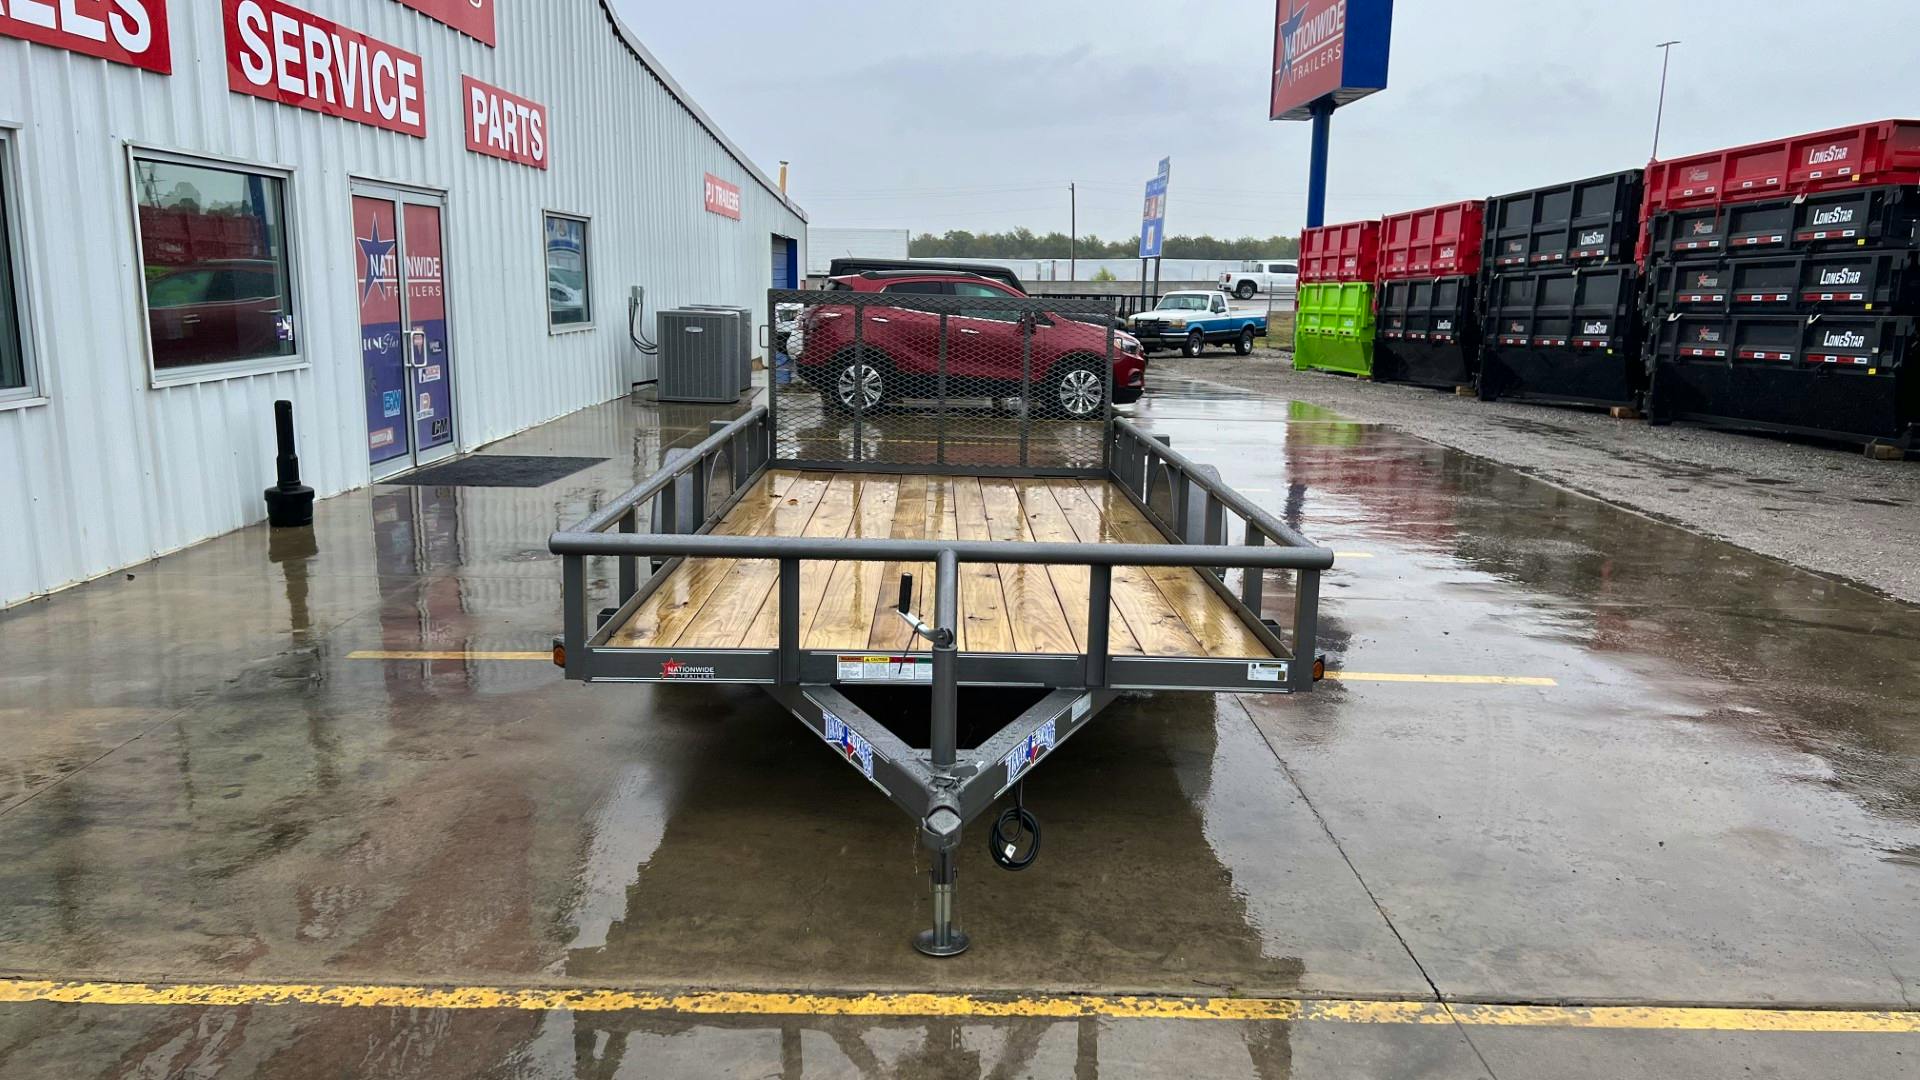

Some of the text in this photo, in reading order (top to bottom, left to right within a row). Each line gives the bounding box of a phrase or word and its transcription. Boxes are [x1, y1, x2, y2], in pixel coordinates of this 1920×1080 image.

[1285, 3, 1344, 60] NATIONWIDE
[236, 0, 420, 127] SERVICE
[1293, 43, 1341, 82] TRAILERS
[471, 88, 544, 161] PARTS
[705, 182, 714, 203] PJ
[370, 254, 440, 277] NATINWIDE
[386, 285, 441, 298] TRILERS
